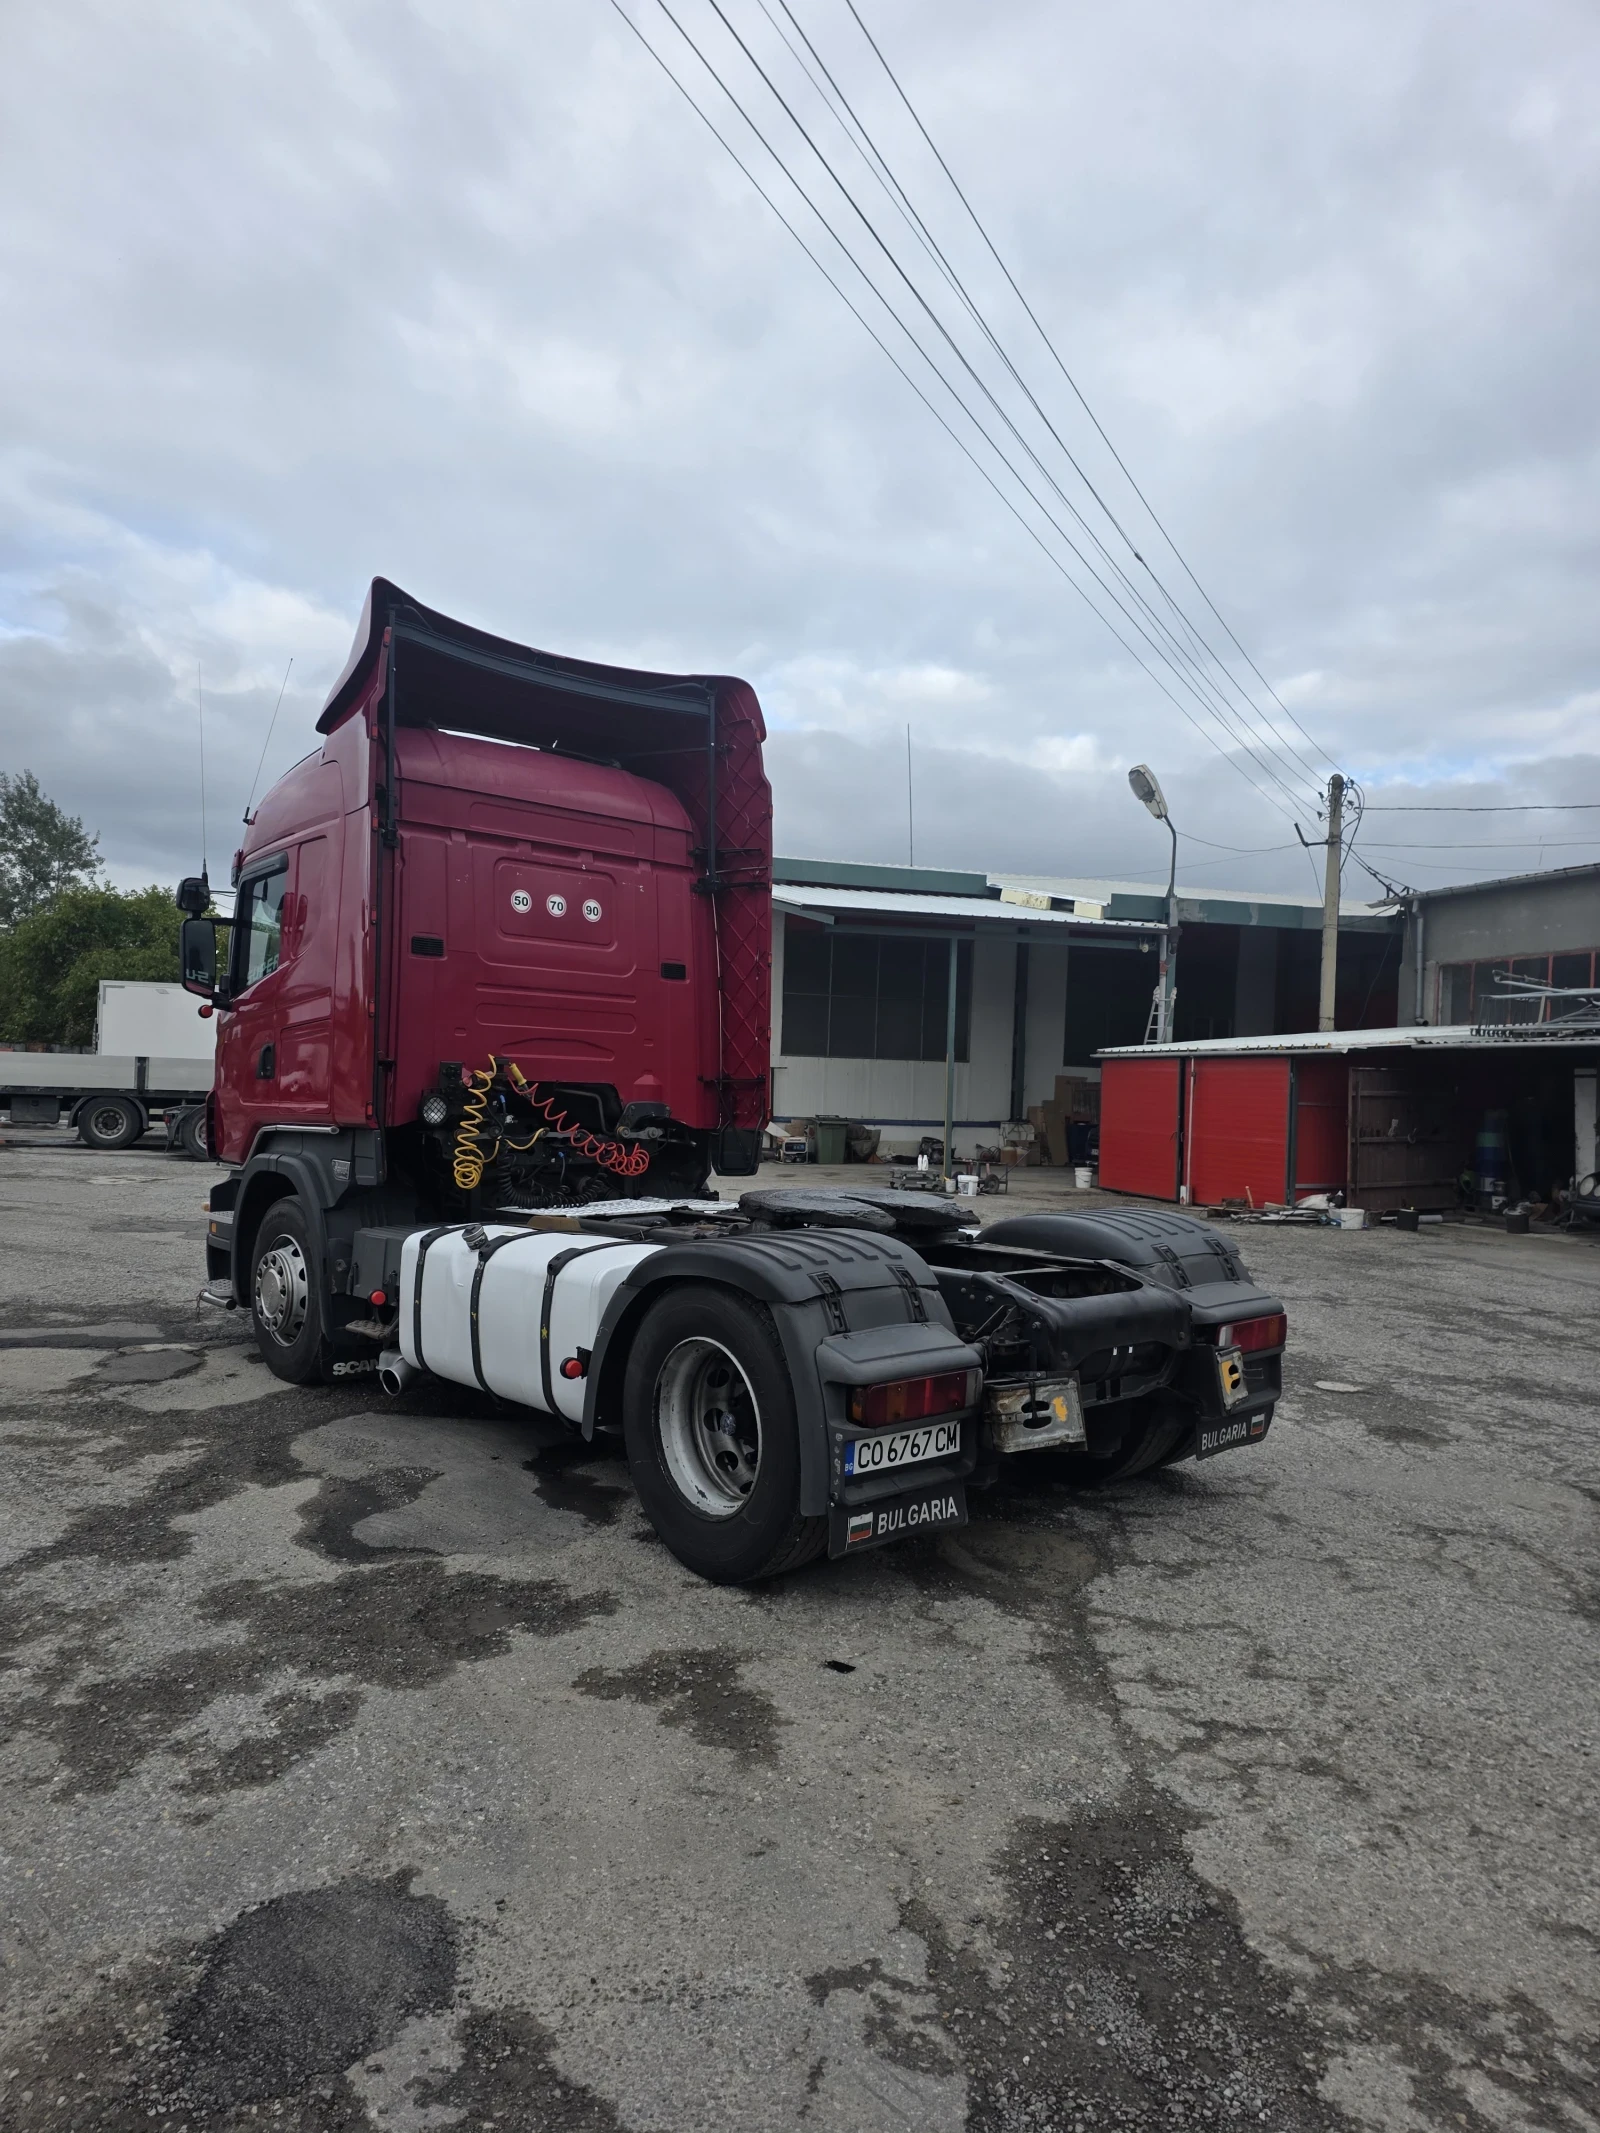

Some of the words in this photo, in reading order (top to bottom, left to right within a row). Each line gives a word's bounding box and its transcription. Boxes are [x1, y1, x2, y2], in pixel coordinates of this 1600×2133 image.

[514, 895, 529, 907] 50
[549, 900, 564, 912] 70
[585, 905, 599, 917] 90
[1201, 1422, 1247, 1451] BULGARIA
[858, 1440, 883, 1469] CO
[887, 1430, 932, 1462] 6767
[935, 1424, 957, 1452] CM
[845, 1463, 853, 1472] BG
[877, 1496, 959, 1535] BULGARIA
